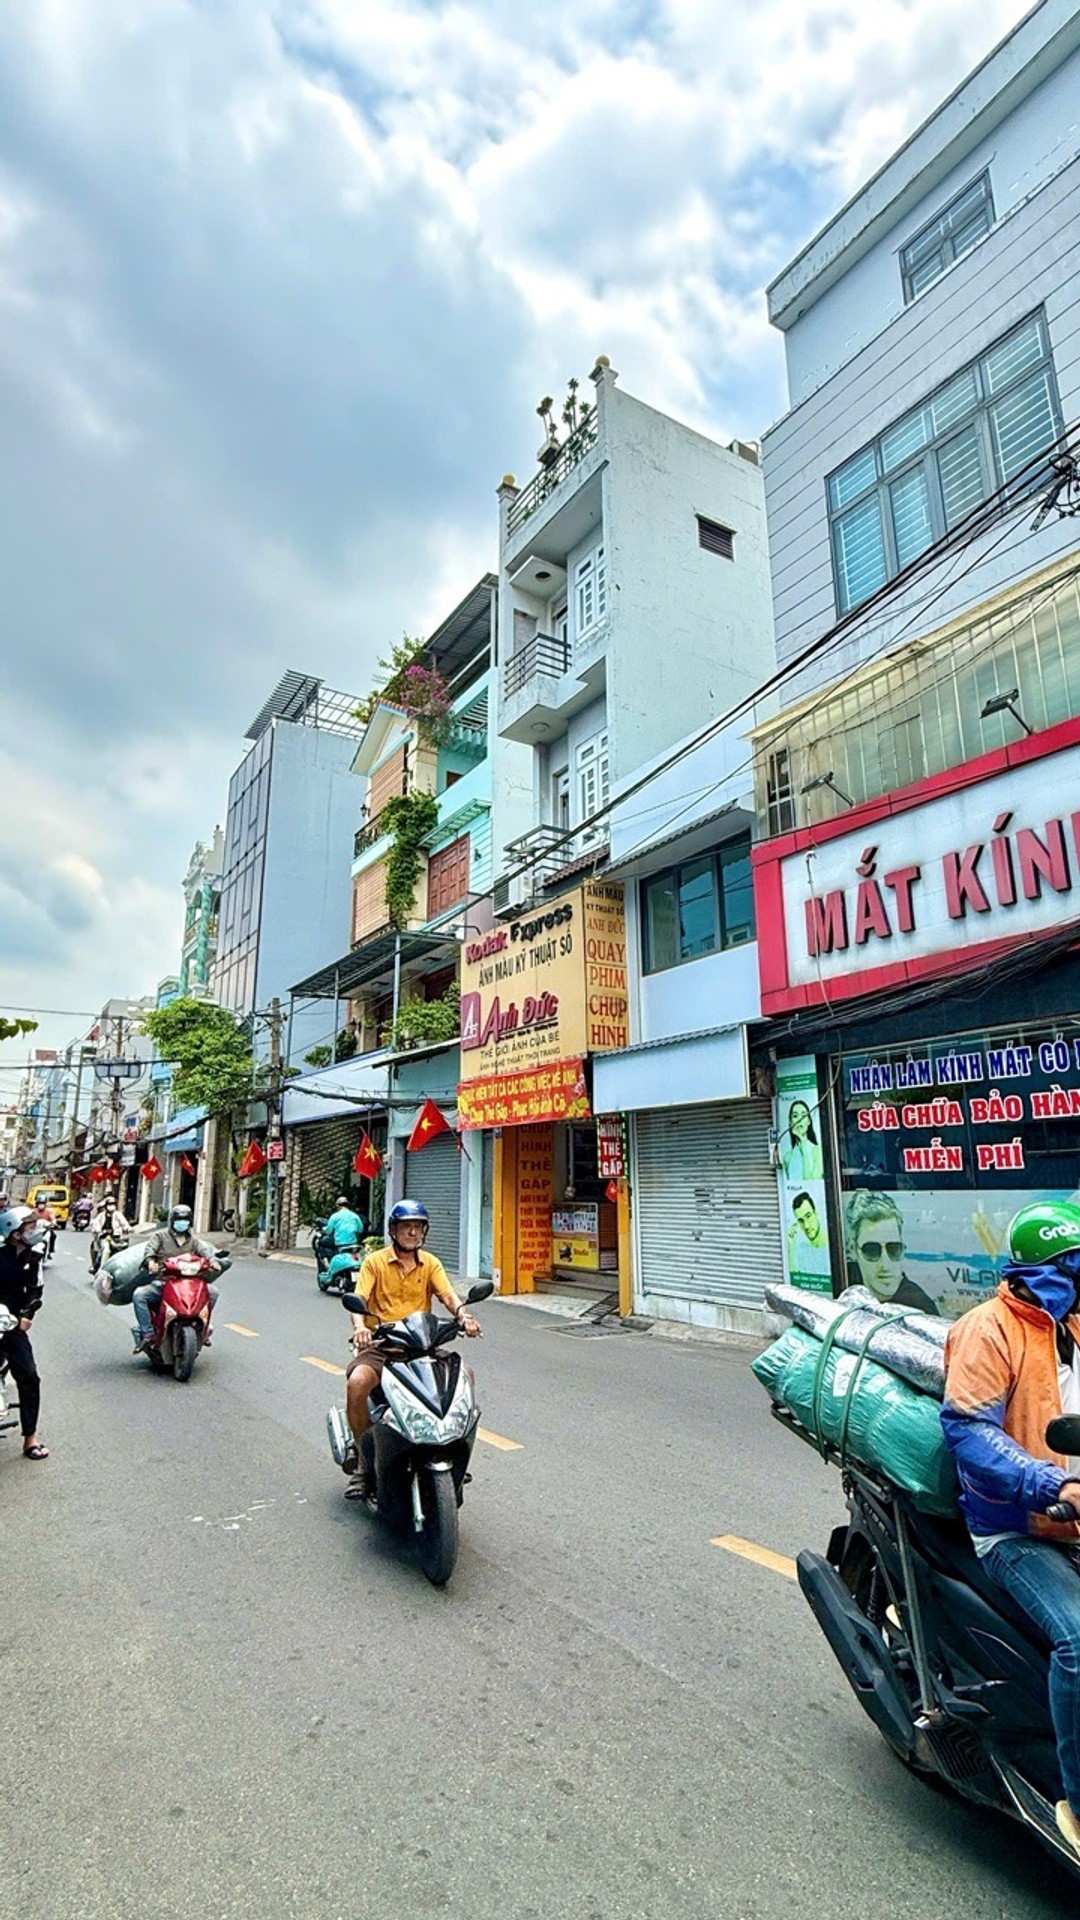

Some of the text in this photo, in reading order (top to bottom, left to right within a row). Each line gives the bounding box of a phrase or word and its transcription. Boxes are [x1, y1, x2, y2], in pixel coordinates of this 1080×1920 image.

[804, 846, 922, 957] MẮT
[465, 903, 573, 965] Kodak Express
[587, 938, 625, 963] QUAY
[589, 966, 626, 989] PHIM
[589, 995, 627, 1022] CHỤP
[851, 1059, 893, 1097] NHẬN
[896, 1054, 933, 1089] LÀM
[936, 1048, 983, 1085] KÍNH
[987, 1040, 1032, 1080] MẮT
[1038, 1033, 1070, 1073] CÓ
[857, 1101, 900, 1133] SỬA
[902, 1096, 964, 1128] CHỮA
[970, 1088, 1024, 1123] BẢO
[602, 1137, 621, 1156] THẺ
[903, 1137, 1025, 1171] MIỄN PHÍ
[602, 1157, 623, 1176] GẤP
[1039, 1220, 1079, 1240] Grab
